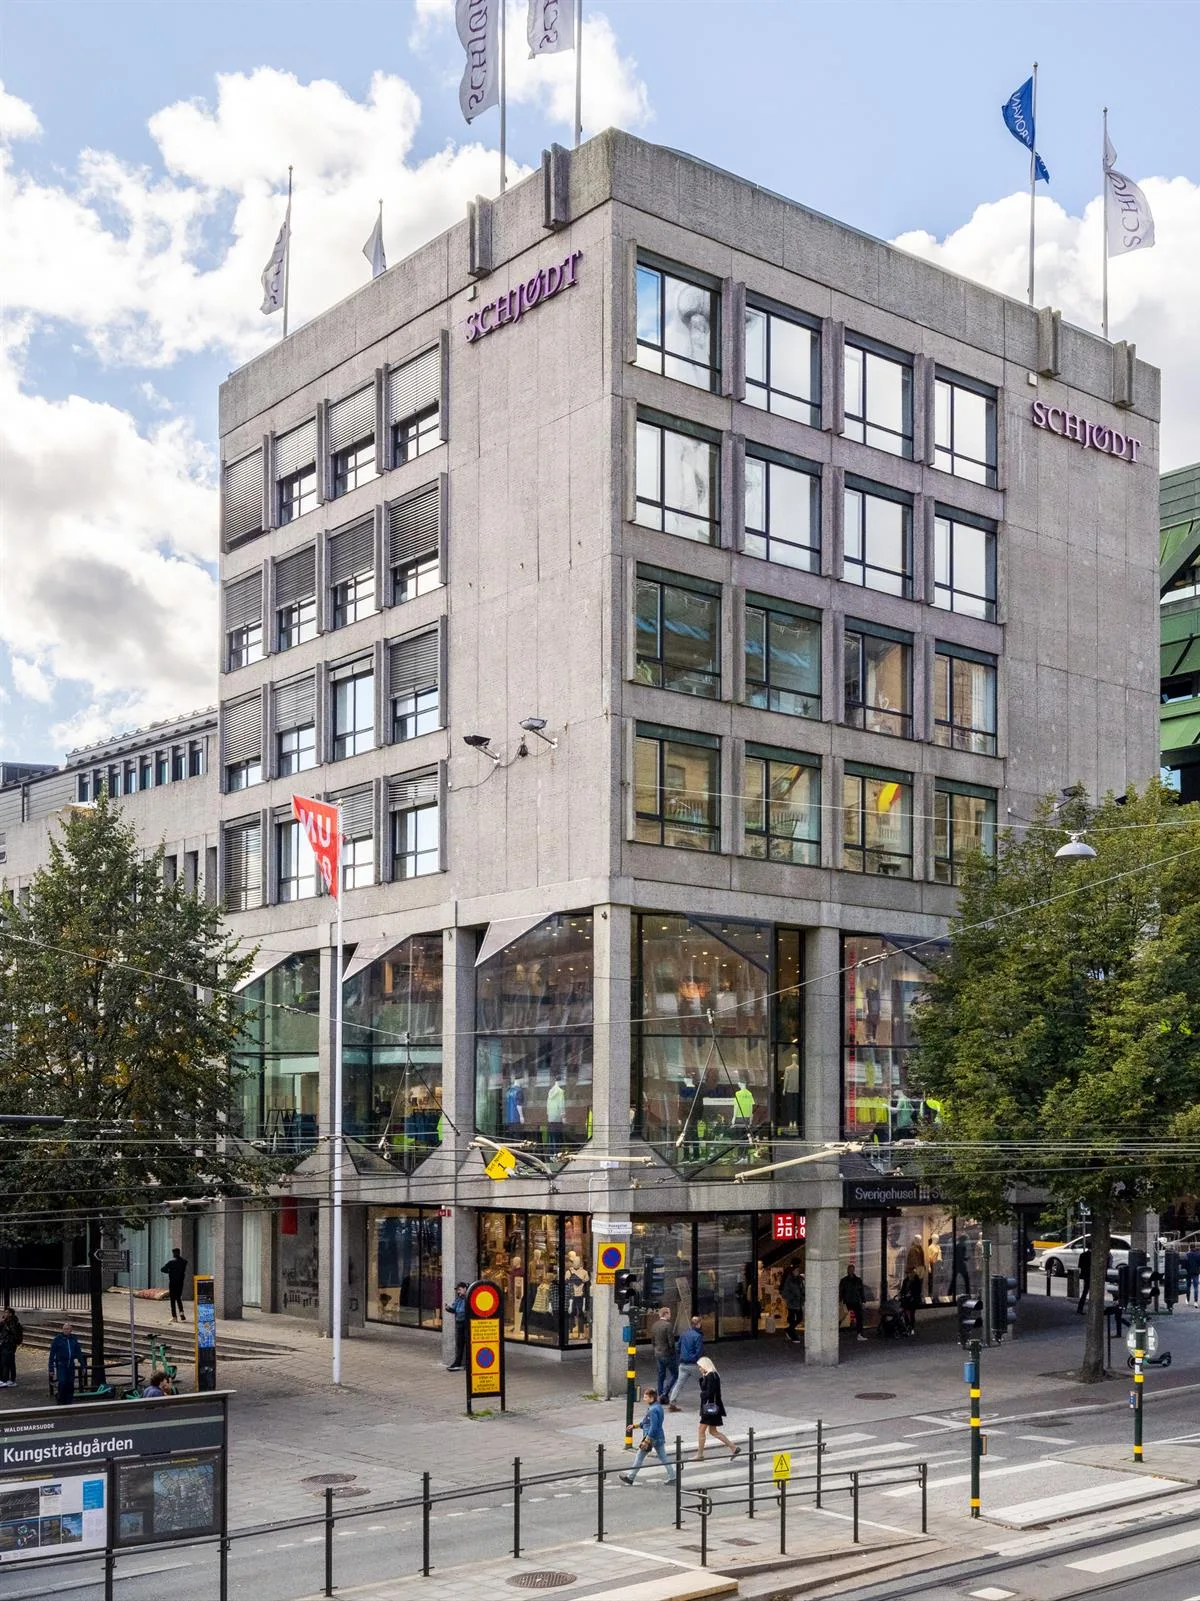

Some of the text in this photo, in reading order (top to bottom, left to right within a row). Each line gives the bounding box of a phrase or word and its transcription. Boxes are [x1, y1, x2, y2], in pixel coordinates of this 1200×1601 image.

[465, 250, 583, 344] SCHJØDT
[1032, 400, 1142, 463] SCHJØDT
[855, 1187, 917, 1203] Sverigehuset
[4, 1423, 55, 1433] WALDEMARSUDDE
[3, 1437, 133, 1464] Kungsträdgården
